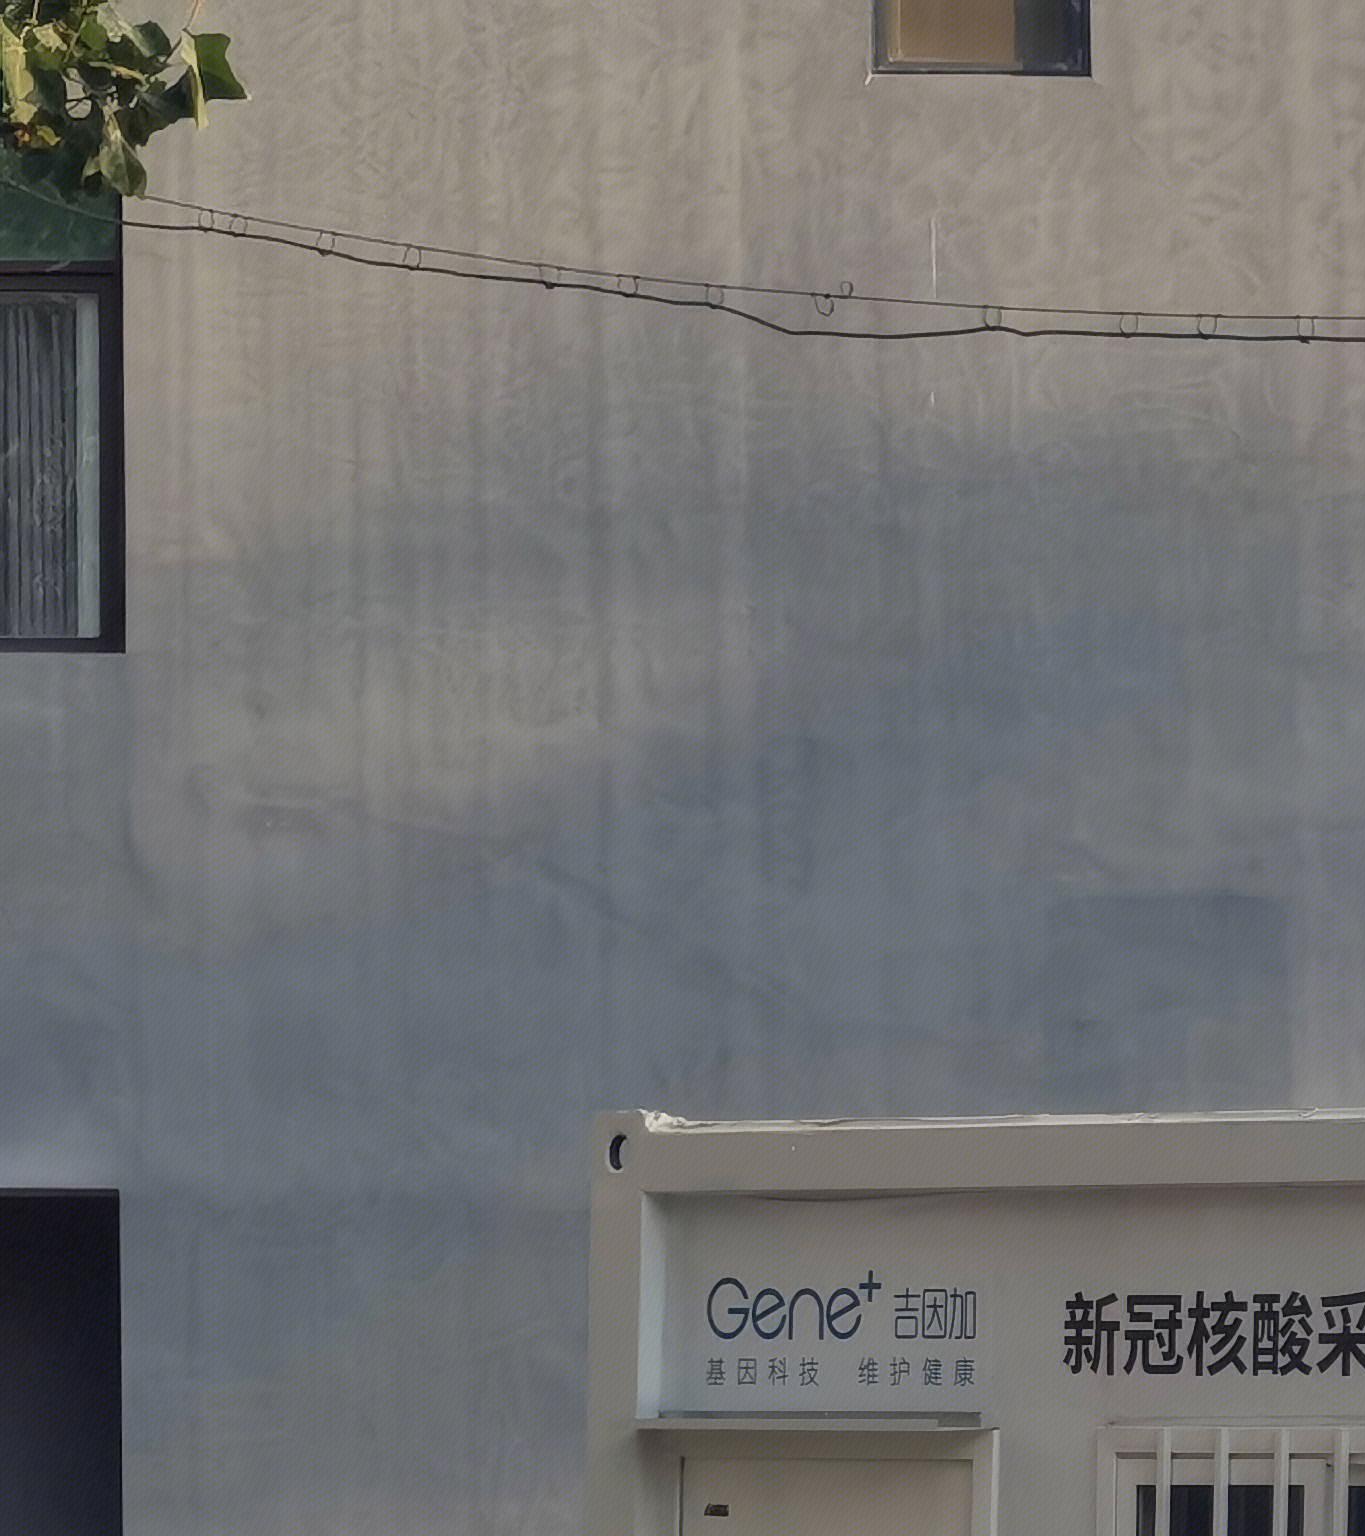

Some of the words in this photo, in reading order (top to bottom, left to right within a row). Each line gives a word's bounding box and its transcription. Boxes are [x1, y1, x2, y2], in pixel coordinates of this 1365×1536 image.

[893, 1287, 977, 1340] 吉因加
[706, 1356, 819, 1387] 基因科技
[858, 1356, 976, 1387] 维护健康
